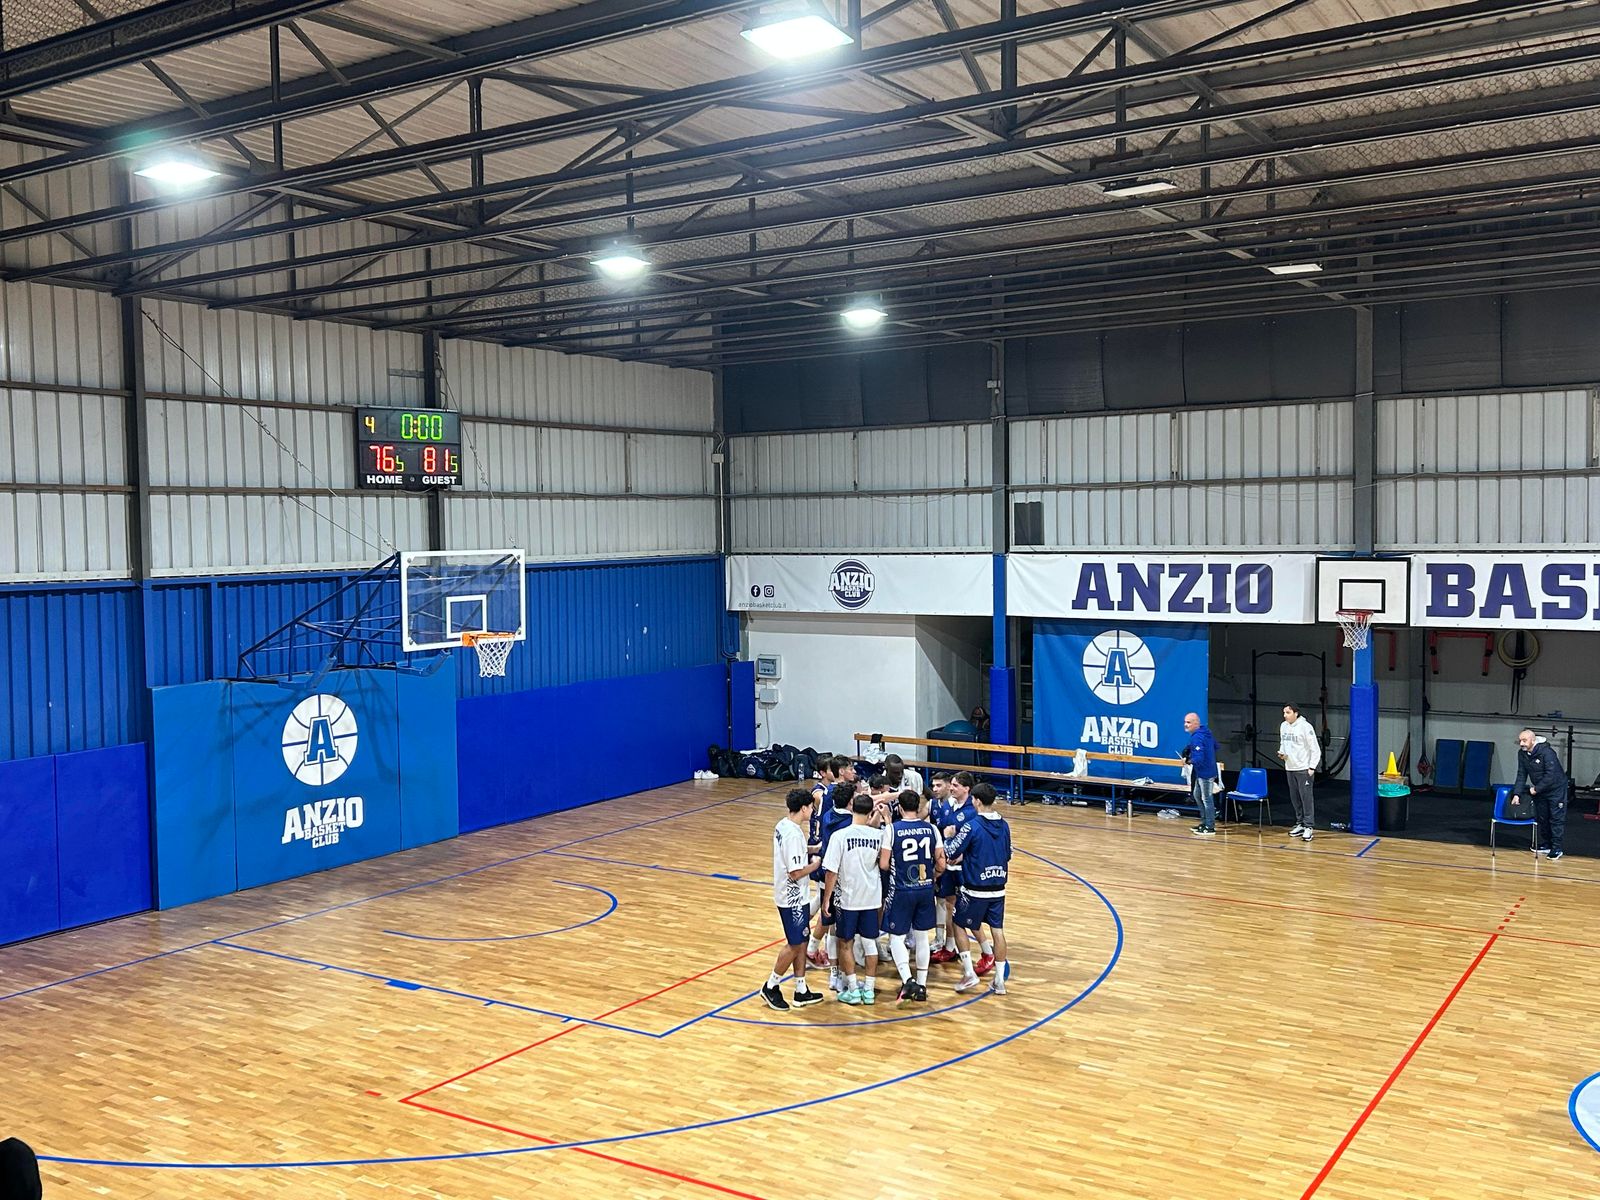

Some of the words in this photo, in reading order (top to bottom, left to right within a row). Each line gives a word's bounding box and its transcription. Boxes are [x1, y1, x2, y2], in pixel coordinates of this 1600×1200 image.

[365, 416, 375, 434] 4
[401, 413, 442, 440] 0:00
[369, 445, 395, 472] 76
[424, 446, 449, 473] 81
[366, 475, 403, 484] HOME
[422, 475, 456, 485] GUEST
[829, 571, 875, 592] ANZIO
[1071, 562, 1274, 614] ANZIO
[1426, 563, 1600, 620] BAS
[1101, 647, 1136, 688] A
[303, 715, 339, 766] A
[1080, 715, 1158, 749] ANZIO
[1101, 735, 1140, 748] BASKET
[1108, 745, 1134, 756] CLUB
[281, 796, 364, 844] ANZIO
[303, 821, 346, 841] BASKET
[312, 833, 339, 849] CLUB
[901, 836, 931, 862] 21
